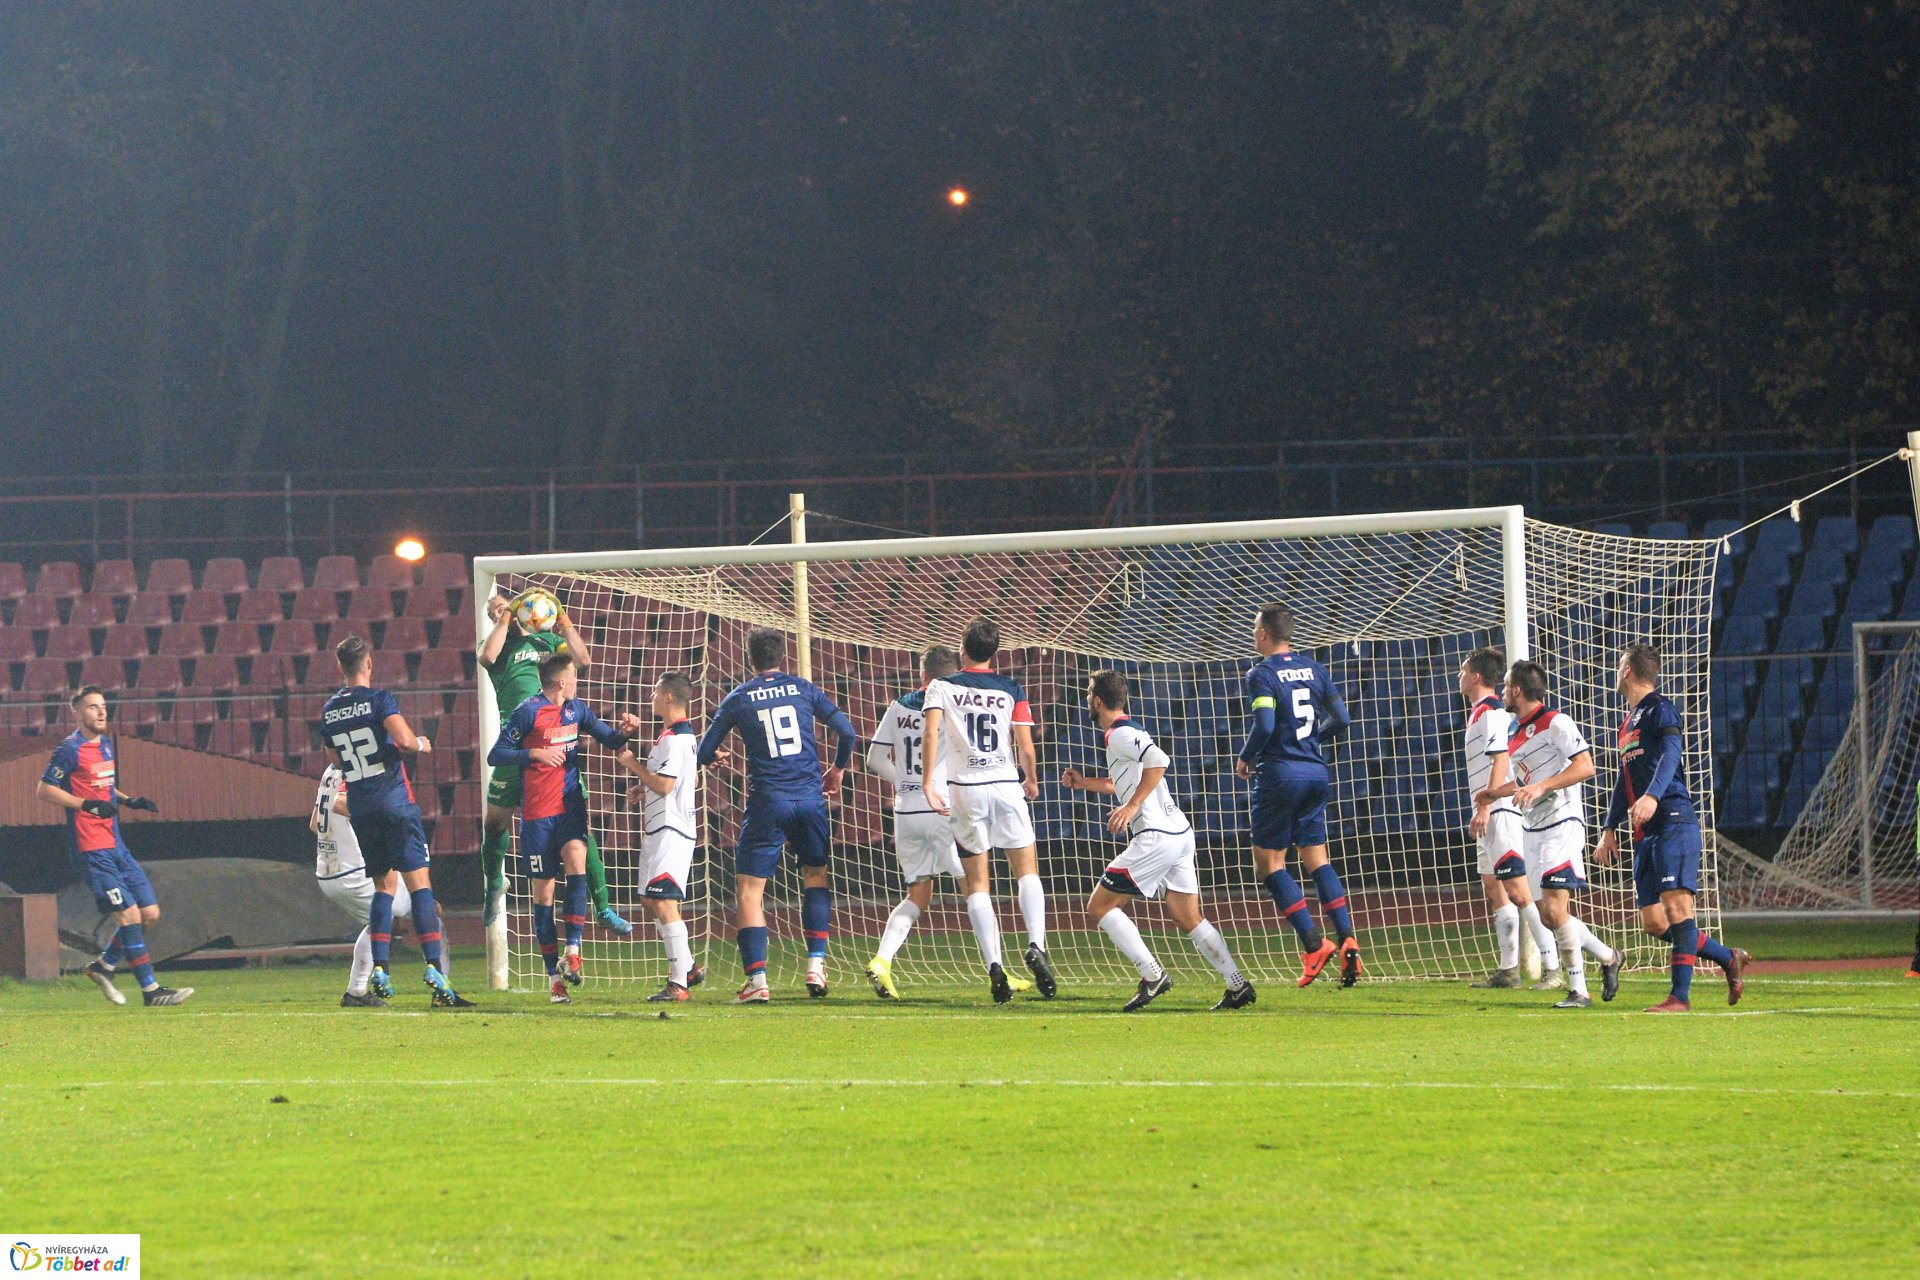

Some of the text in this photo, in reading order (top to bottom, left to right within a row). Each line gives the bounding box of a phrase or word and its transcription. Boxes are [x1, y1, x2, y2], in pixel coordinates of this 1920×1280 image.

[747, 684, 800, 702] TÓTH B.
[953, 692, 1005, 709] VÁC FC
[324, 702, 371, 724] SZEKSZÁRDI
[897, 715, 920, 729] VÁC
[1292, 688, 1315, 740] 5
[757, 705, 802, 758] 19
[964, 713, 998, 752] 16
[332, 727, 385, 782] 32
[530, 855, 543, 873] 21
[106, 888, 122, 905] 10
